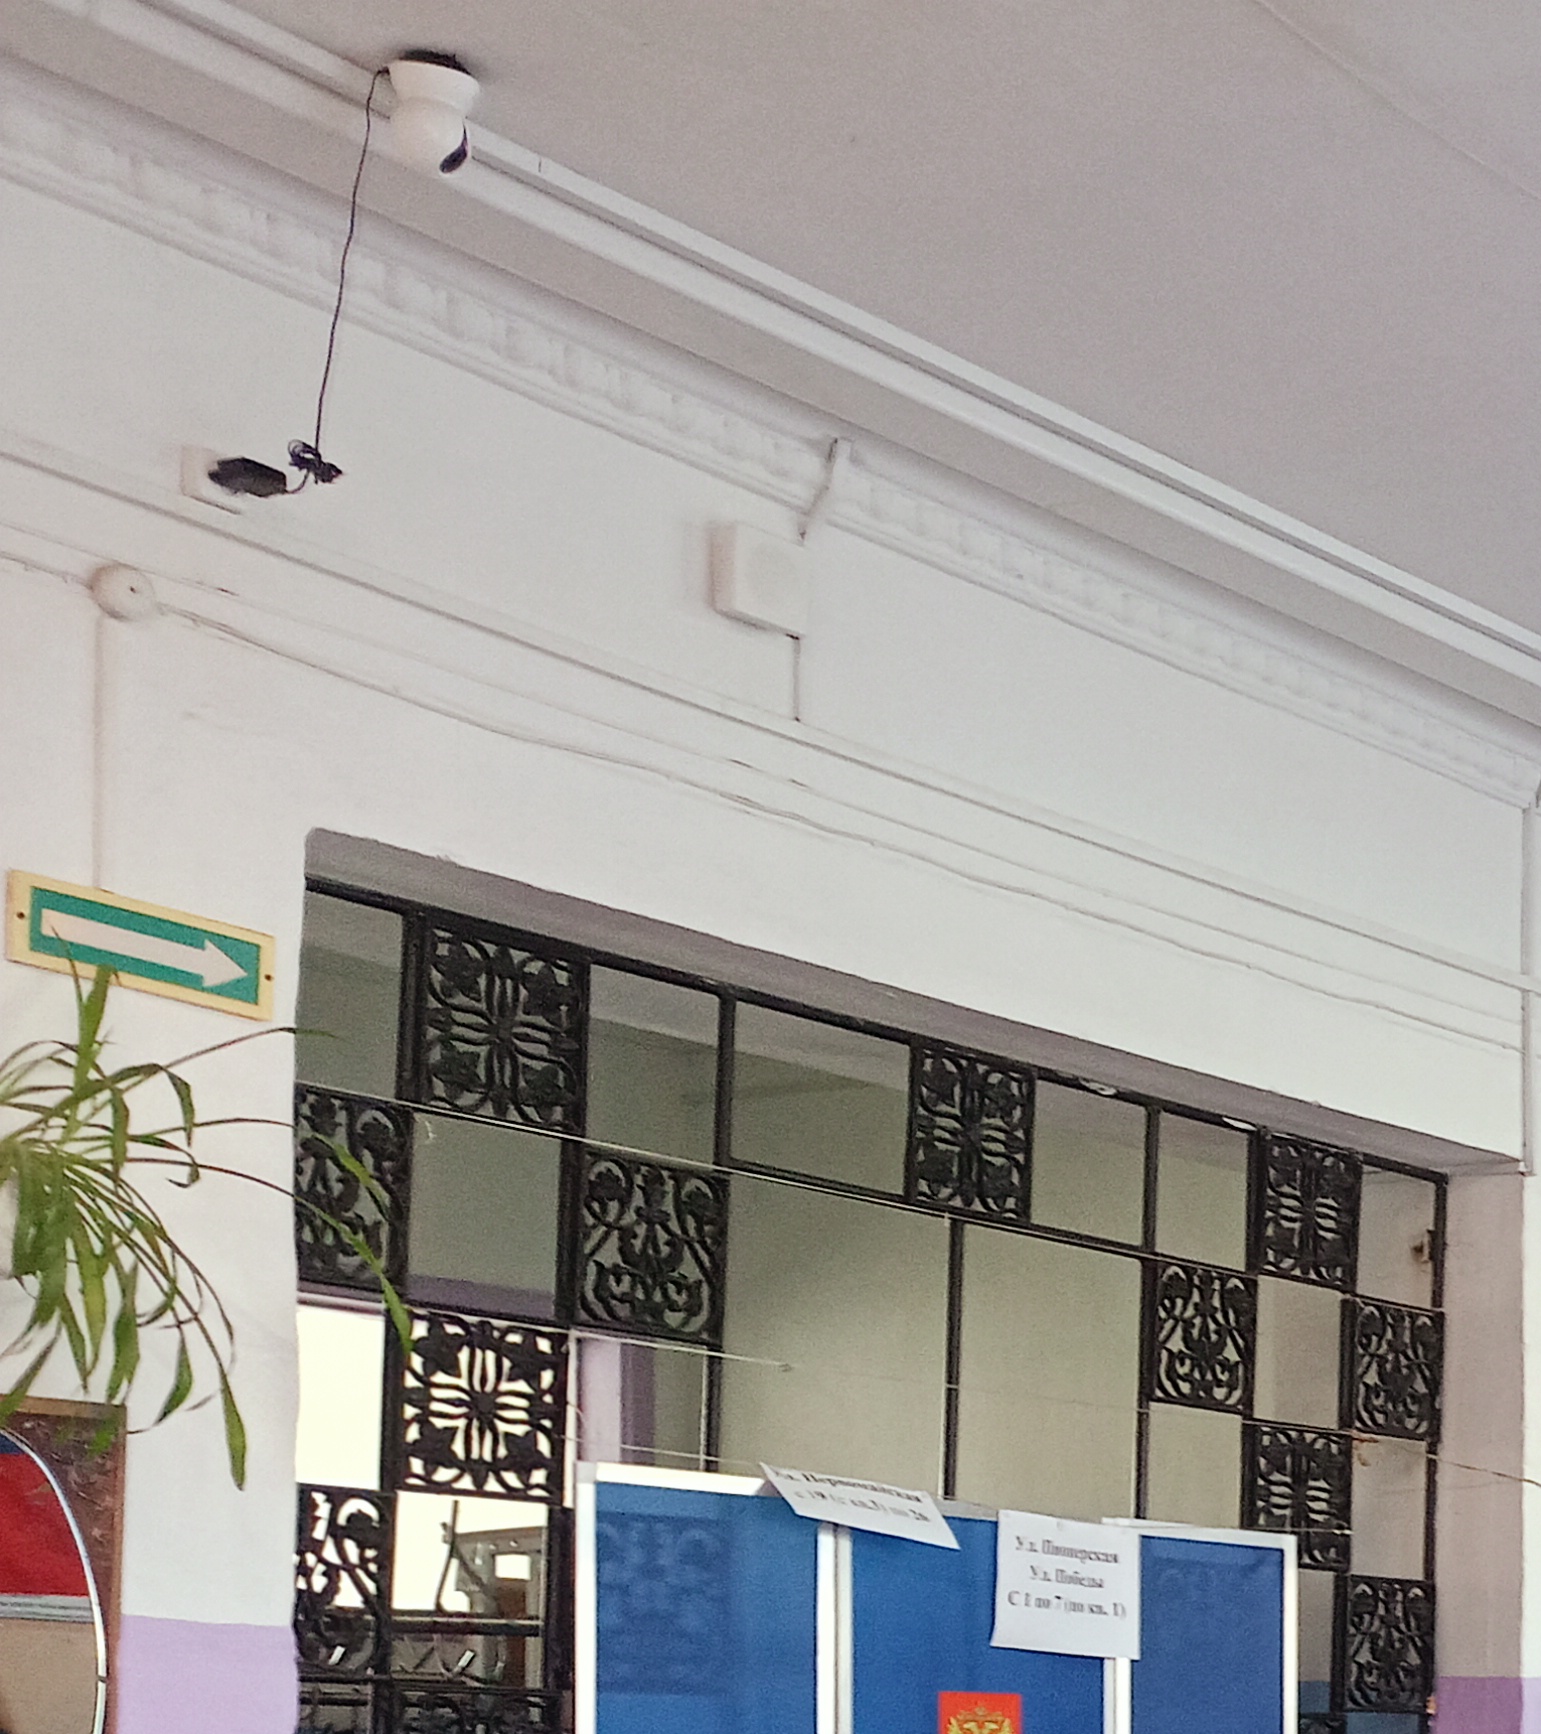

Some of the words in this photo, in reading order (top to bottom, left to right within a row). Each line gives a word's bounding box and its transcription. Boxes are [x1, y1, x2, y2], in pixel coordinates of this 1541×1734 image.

[1015, 1535, 1039, 1553] Ул.
[1042, 1539, 1119, 1564] Пионерская
[1030, 1565, 1052, 1583] Ул.
[1055, 1568, 1105, 1589] Победы
[1007, 1590, 1021, 1606] С
